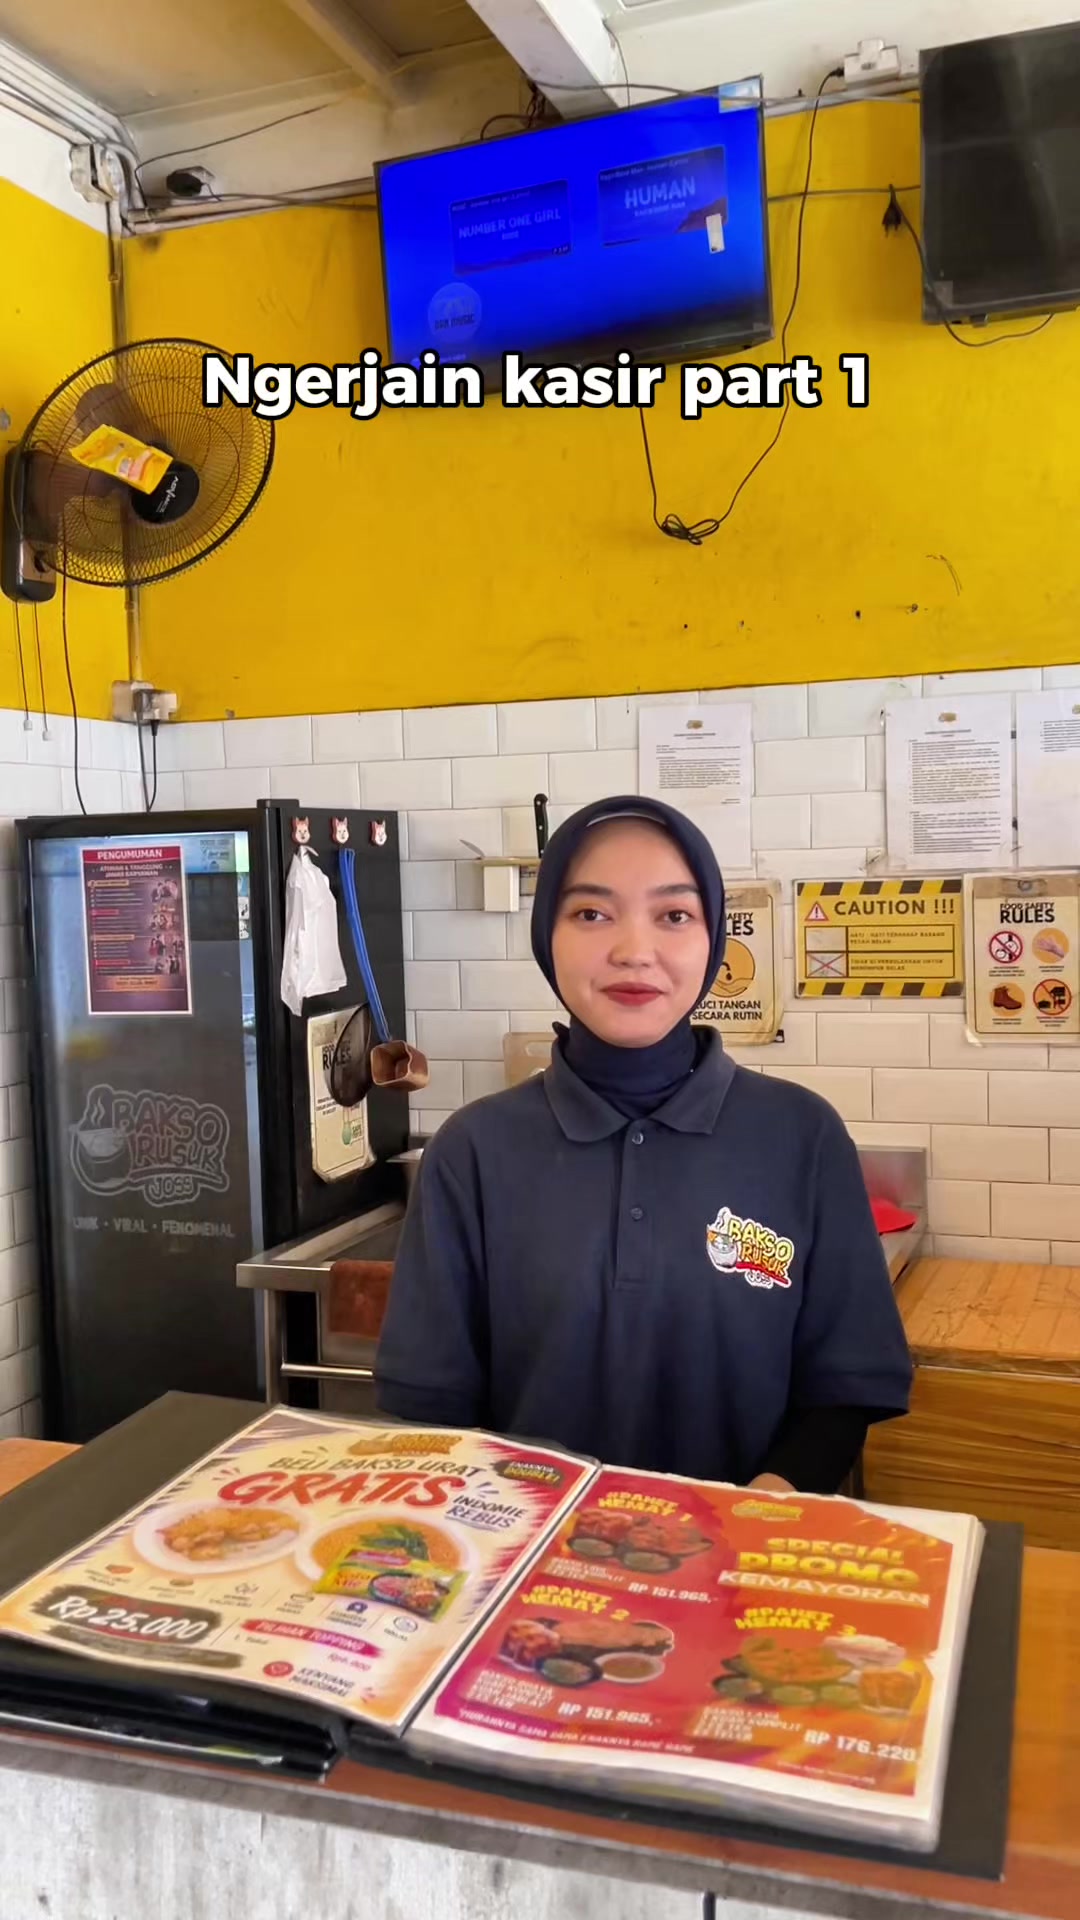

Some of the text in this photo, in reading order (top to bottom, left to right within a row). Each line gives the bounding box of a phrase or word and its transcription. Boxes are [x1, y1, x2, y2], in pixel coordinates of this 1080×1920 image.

[625, 176, 696, 209] HUMAN
[458, 219, 506, 239] NUMBER
[508, 213, 532, 229] ONE
[534, 208, 561, 223] GIRL
[97, 849, 162, 860] PENGUMUMAN
[727, 912, 753, 921] AFETY
[834, 899, 955, 916] CAUTION !!!
[1000, 902, 1054, 911] FOOD SAFETY
[1000, 909, 1055, 923] RULES
[692, 1011, 762, 1020] SECARA RUTIN
[719, 1001, 761, 1010] TANGAN
[112, 1098, 223, 1146] BAKSO
[135, 1134, 222, 1173] RUSUK
[150, 1175, 193, 1199] JOSS
[113, 1218, 148, 1233] VIRAL
[728, 1218, 793, 1262] BAKSO
[740, 1242, 787, 1277] RUSUK
[267, 1457, 488, 1478] BELI BAKSO URAT
[217, 1471, 467, 1508] GRATIS
[605, 1491, 680, 1508] #PAKET
[446, 1505, 517, 1529] REBUS
[453, 1494, 528, 1519] INDOMIE
[598, 1498, 693, 1522] HEMAT 1
[767, 1537, 904, 1566] SPECIAL
[738, 1551, 920, 1587] PROMO
[532, 1585, 612, 1603] #PAKET
[627, 1581, 649, 1593] RP
[718, 1569, 931, 1608] KEMAYORAN
[520, 1593, 631, 1621] HEMAT 2
[743, 1606, 835, 1621] #PAKET
[735, 1616, 858, 1636] HEMAT 3
[308, 1630, 366, 1651] TOPPING
[299, 1667, 355, 1689] KENYANG
[558, 1702, 582, 1716] RP
[804, 1729, 831, 1746] RP
